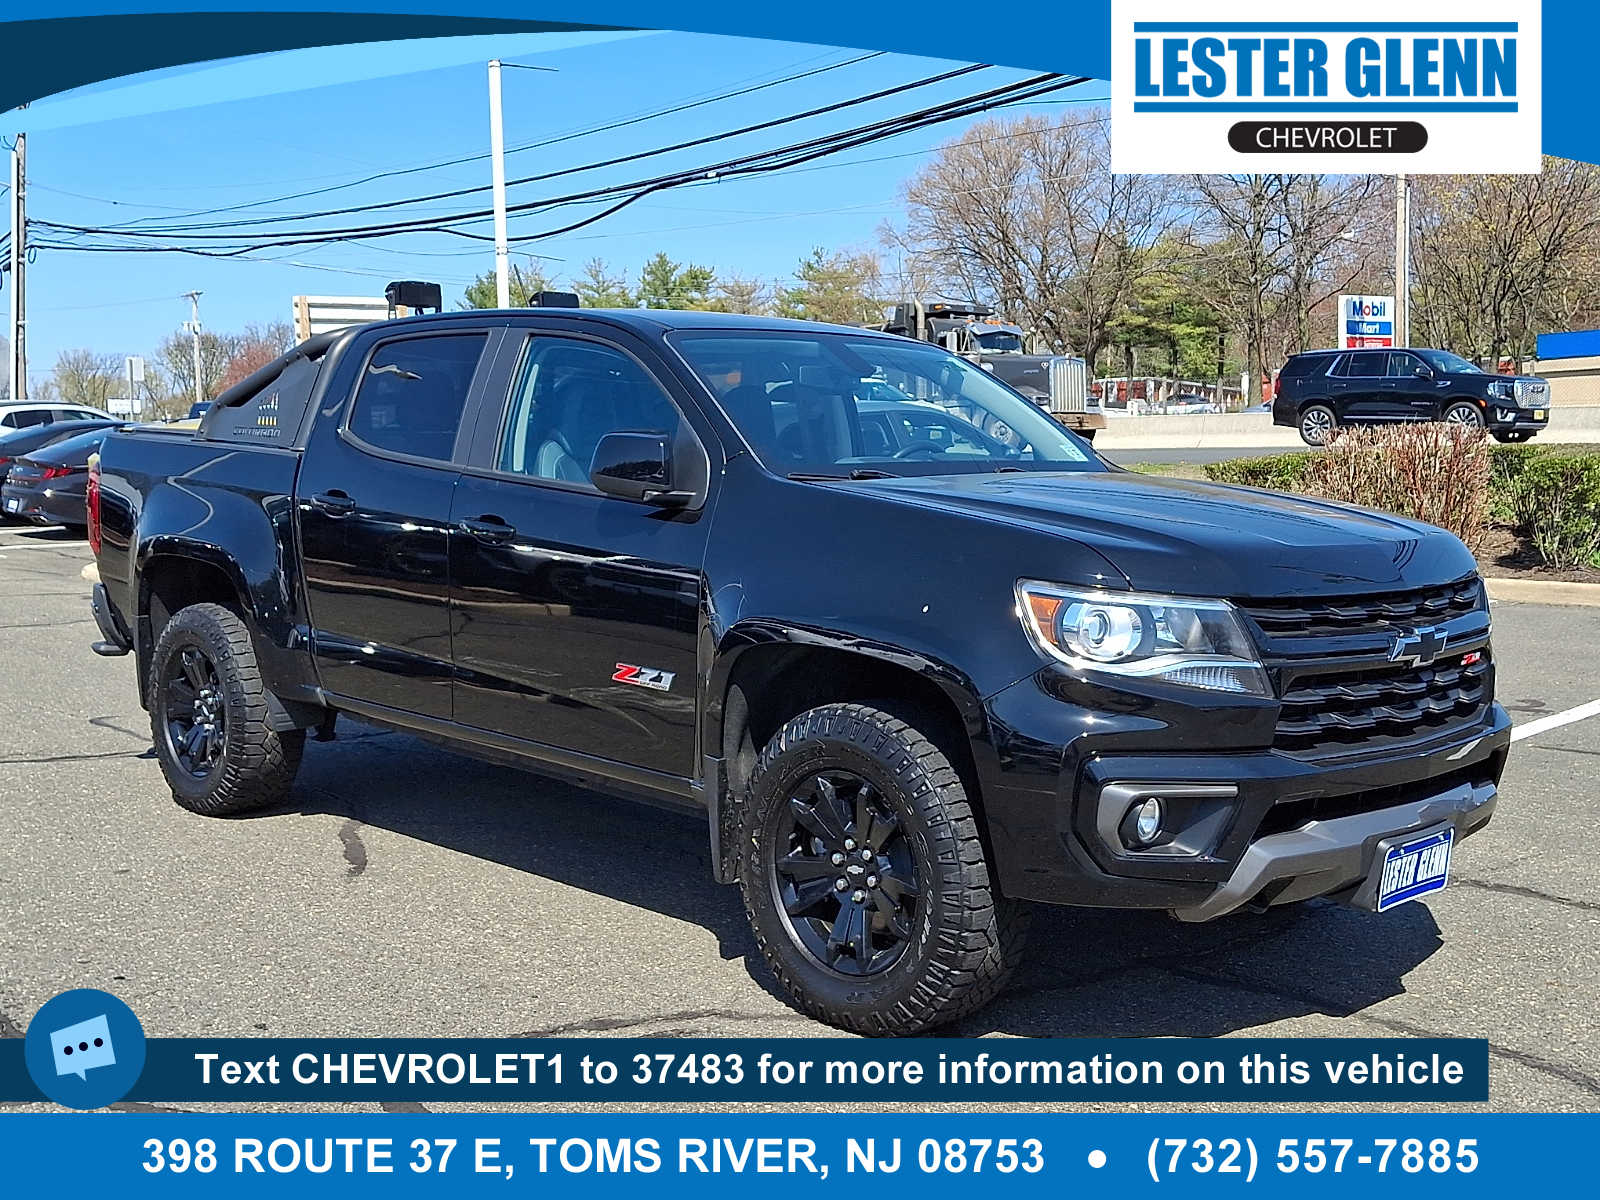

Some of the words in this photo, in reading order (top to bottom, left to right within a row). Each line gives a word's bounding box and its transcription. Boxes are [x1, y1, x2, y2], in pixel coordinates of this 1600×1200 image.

[1352, 300, 1386, 317] Mobil
[612, 662, 678, 690] Z71
[1382, 853, 1419, 896] LESTER
[1416, 842, 1450, 882] GLENN
